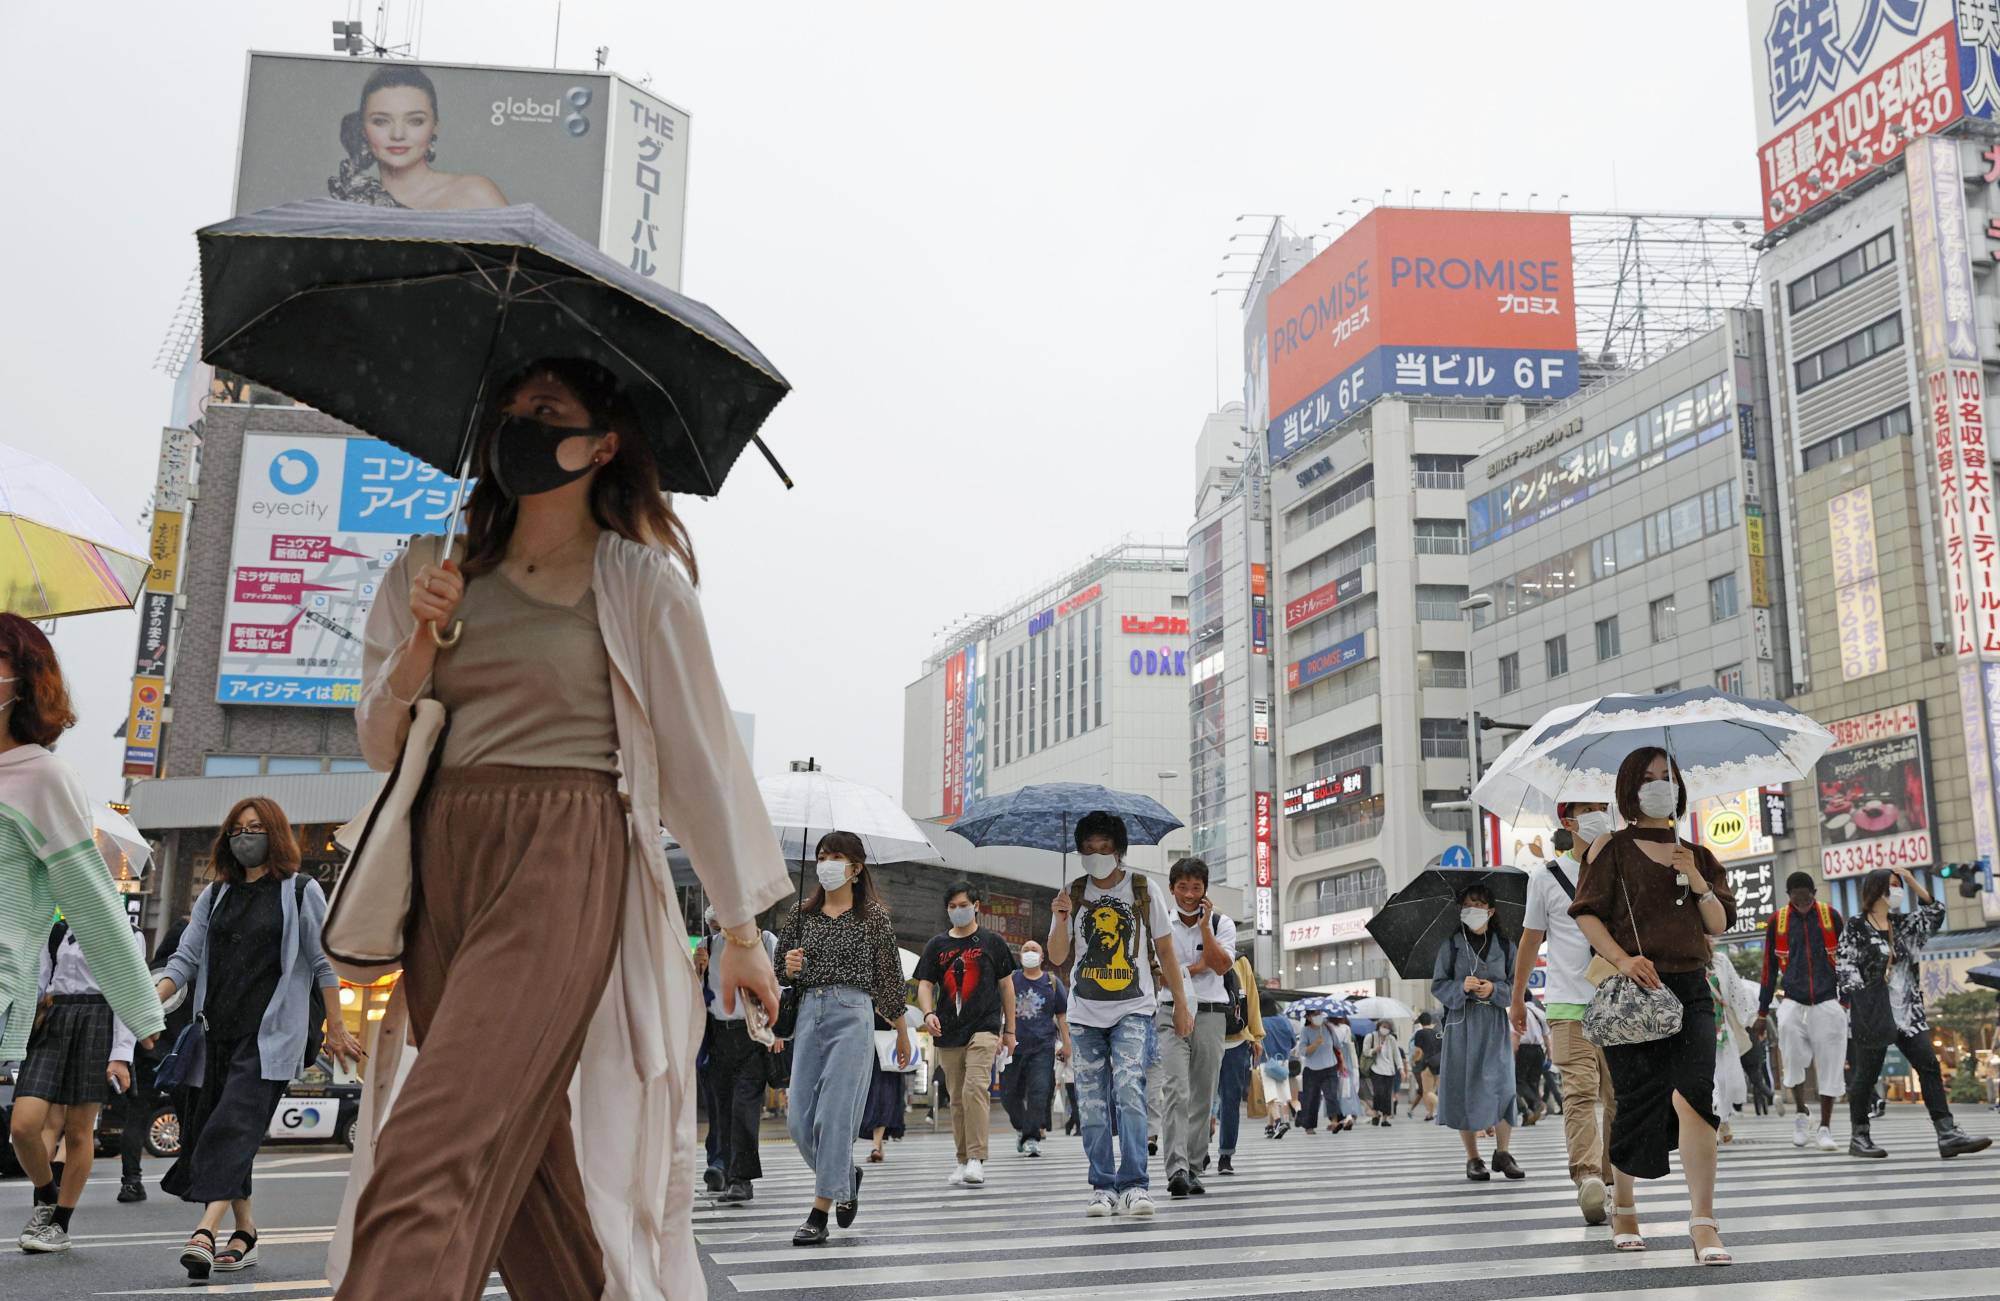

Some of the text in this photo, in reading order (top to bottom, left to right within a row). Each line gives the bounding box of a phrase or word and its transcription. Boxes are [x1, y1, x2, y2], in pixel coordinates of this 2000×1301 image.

[491, 97, 560, 126] global
[630, 100, 674, 141] THE
[631, 136, 664, 276] グローバル
[1392, 256, 1559, 292] PROMISE
[1274, 260, 1369, 364] PROMISE
[1497, 294, 1560, 315] プロミス
[1332, 304, 1371, 347] プロミス
[1396, 352, 1564, 389] 当ビル 6F
[1283, 368, 1365, 450] 当ビル 6F
[253, 500, 328, 521] eyecity
[275, 538, 327, 548] ニュウマン
[310, 551, 325, 559] 4F
[152, 569, 173, 580] 3F
[1121, 616, 1189, 635] ビックカ
[136, 706, 155, 739] 松屋
[1257, 794, 1269, 836] カラオケ
[1290, 925, 1320, 943] カラオケ
